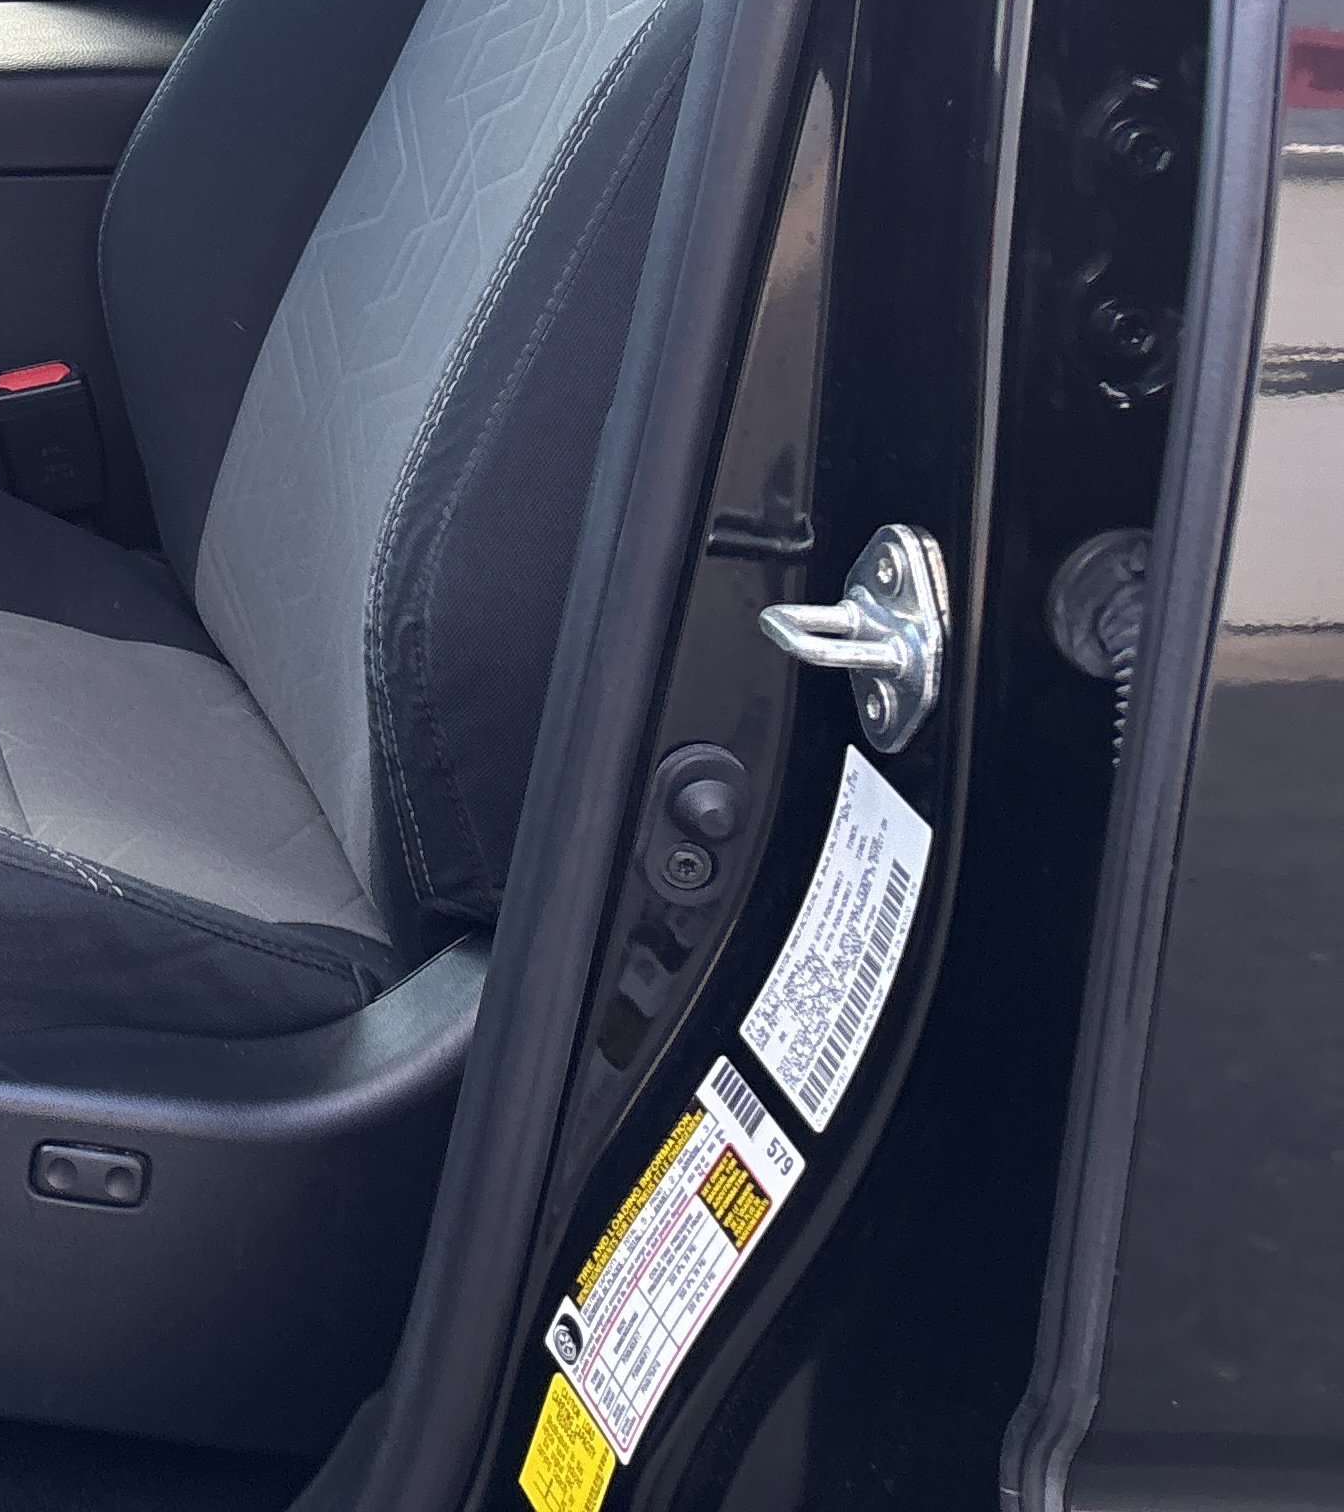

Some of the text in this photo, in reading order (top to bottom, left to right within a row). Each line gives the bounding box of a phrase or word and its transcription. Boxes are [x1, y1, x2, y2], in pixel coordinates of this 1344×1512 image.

[576, 1258, 596, 1286] TIRE
[591, 1234, 610, 1262] AND
[606, 1185, 641, 1237] LOADING
[639, 1110, 691, 1189] INFORMATION
[767, 1136, 793, 1176] 579
